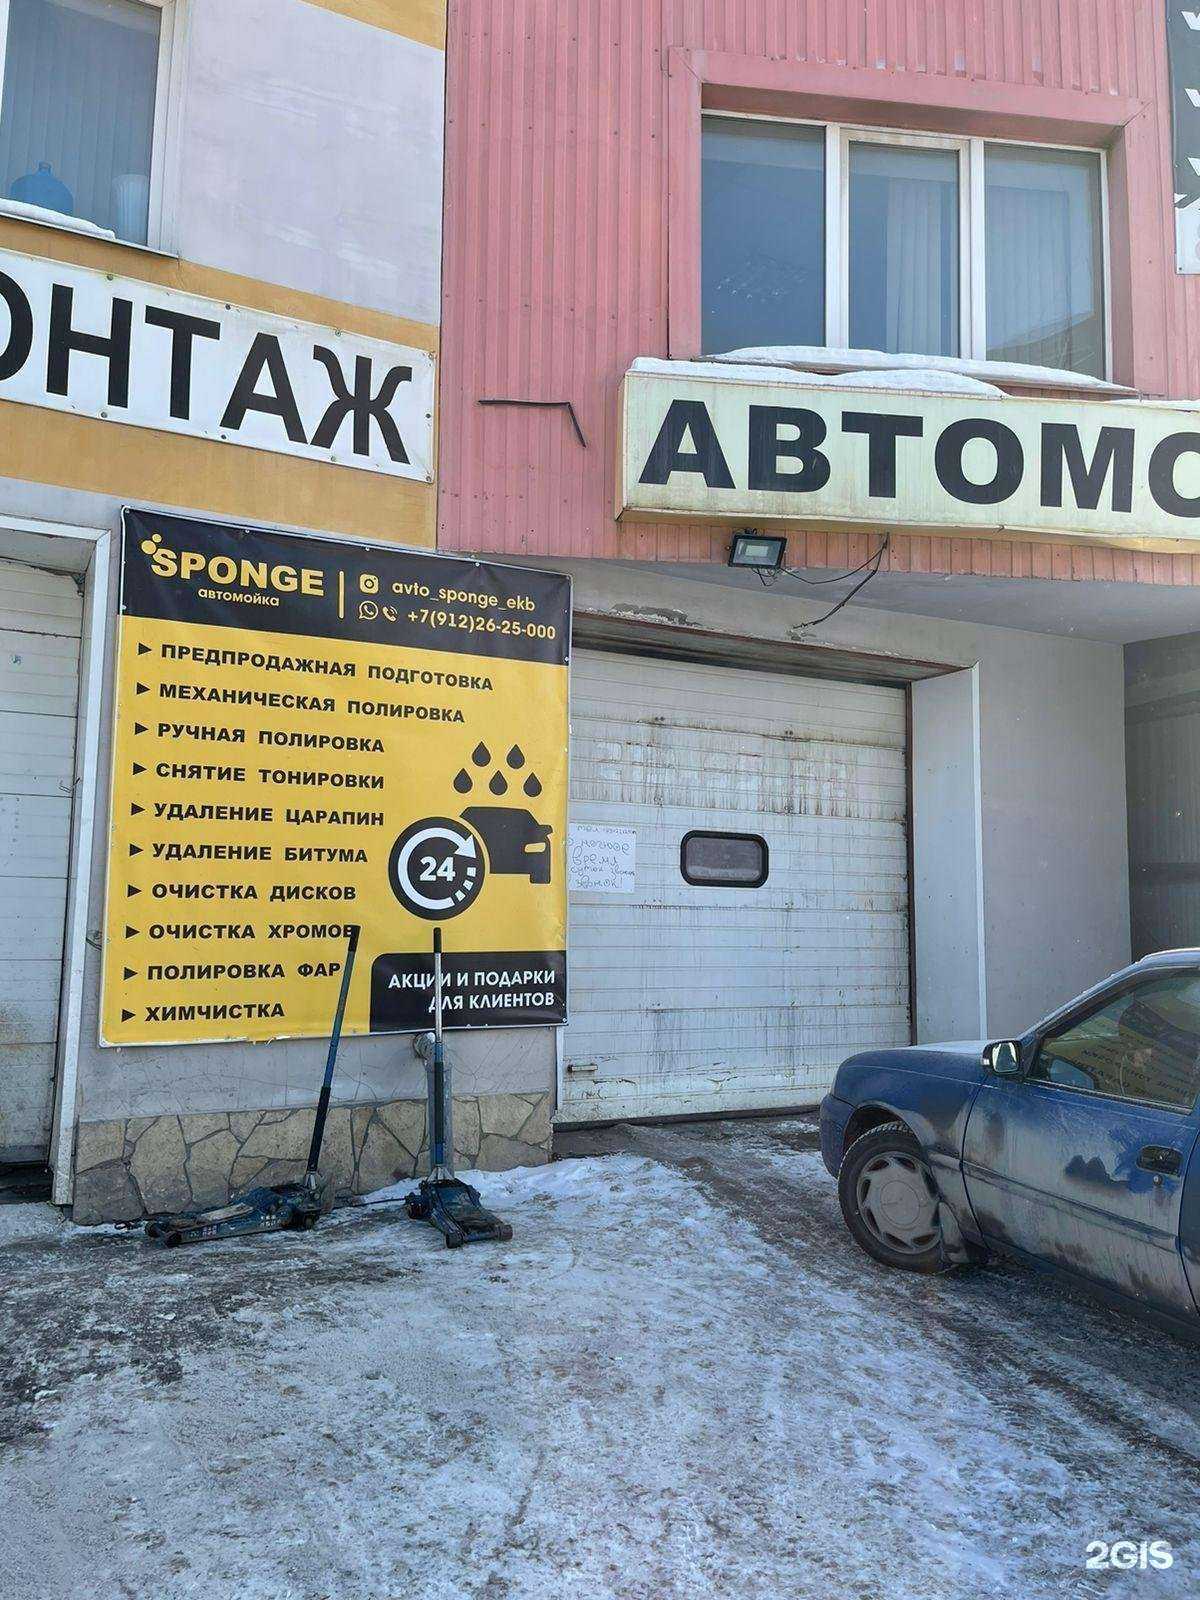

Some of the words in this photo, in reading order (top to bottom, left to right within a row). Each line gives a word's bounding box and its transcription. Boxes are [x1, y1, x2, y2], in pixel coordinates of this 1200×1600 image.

[151, 547, 325, 597] SPONGE
[198, 588, 280, 608] автомойка
[392, 581, 536, 612] avto_sponge_ekb
[407, 608, 556, 640] +7(912)26-25-000
[161, 643, 356, 677] ПРЕДПРОДАЖНАЯ
[368, 665, 493, 691] ПОДГОТОВКА
[159, 683, 335, 712] МЕХАНИЧЕСКАЯ
[347, 700, 465, 723] ПОЛИРОВКА
[157, 722, 246, 743] РУЧНАЯ
[258, 730, 385, 753] ПОЛИРОВКА
[156, 762, 246, 782] СНЯТИЕ
[258, 768, 384, 790] ТОНИРОВКИ
[154, 802, 274, 822] УДАЛЕНИЕ
[285, 808, 385, 826] ЦАРАПИН
[152, 843, 272, 861] УДАЛЕНИЕ
[284, 847, 368, 863] БИТУМА
[419, 855, 457, 882] 24
[151, 883, 258, 900] ОЧИСТКА
[270, 885, 357, 902] ДИСКОВ
[149, 923, 256, 940] ОЧИСТКА
[147, 963, 285, 981] ПОЛИРОВКА
[297, 962, 341, 978] ФАР
[457, 973, 469, 987] И
[474, 970, 556, 988] ПОДАРКИ
[469, 991, 556, 1010] КЛИЕНТОВ
[145, 1003, 286, 1023] ХИМЧИСТКА
